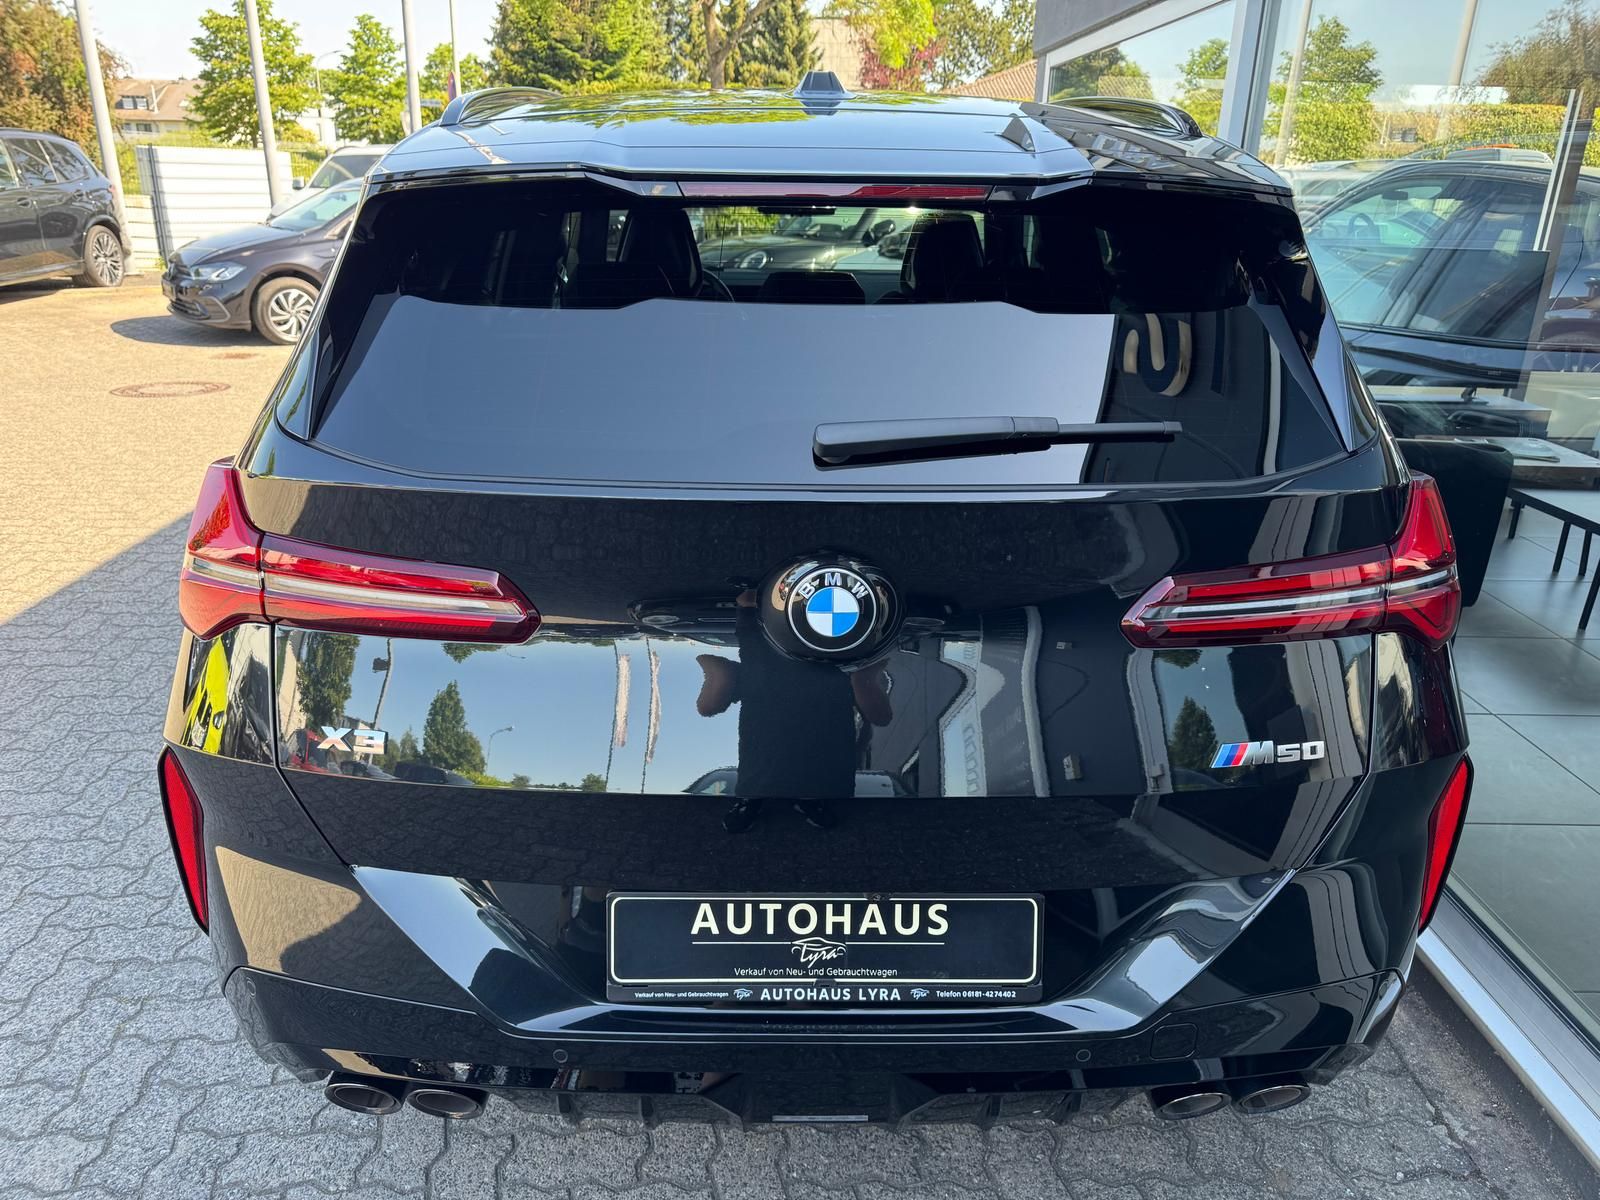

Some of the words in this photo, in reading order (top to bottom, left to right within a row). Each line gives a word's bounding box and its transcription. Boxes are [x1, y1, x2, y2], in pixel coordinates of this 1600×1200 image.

[798, 572, 869, 600] BMW
[316, 725, 386, 755] X3
[1238, 740, 1325, 767] M50
[690, 902, 949, 936] AUTOHAUS
[733, 967, 767, 977] Verkauf
[767, 968, 785, 976] von
[785, 967, 807, 976] Neu-
[808, 966, 825, 976] und
[826, 967, 898, 978] Gebrauchtwagen
[759, 987, 851, 1001] AUTOHAUS
[858, 987, 901, 1001] LYRA
[936, 990, 961, 998] Telefon
